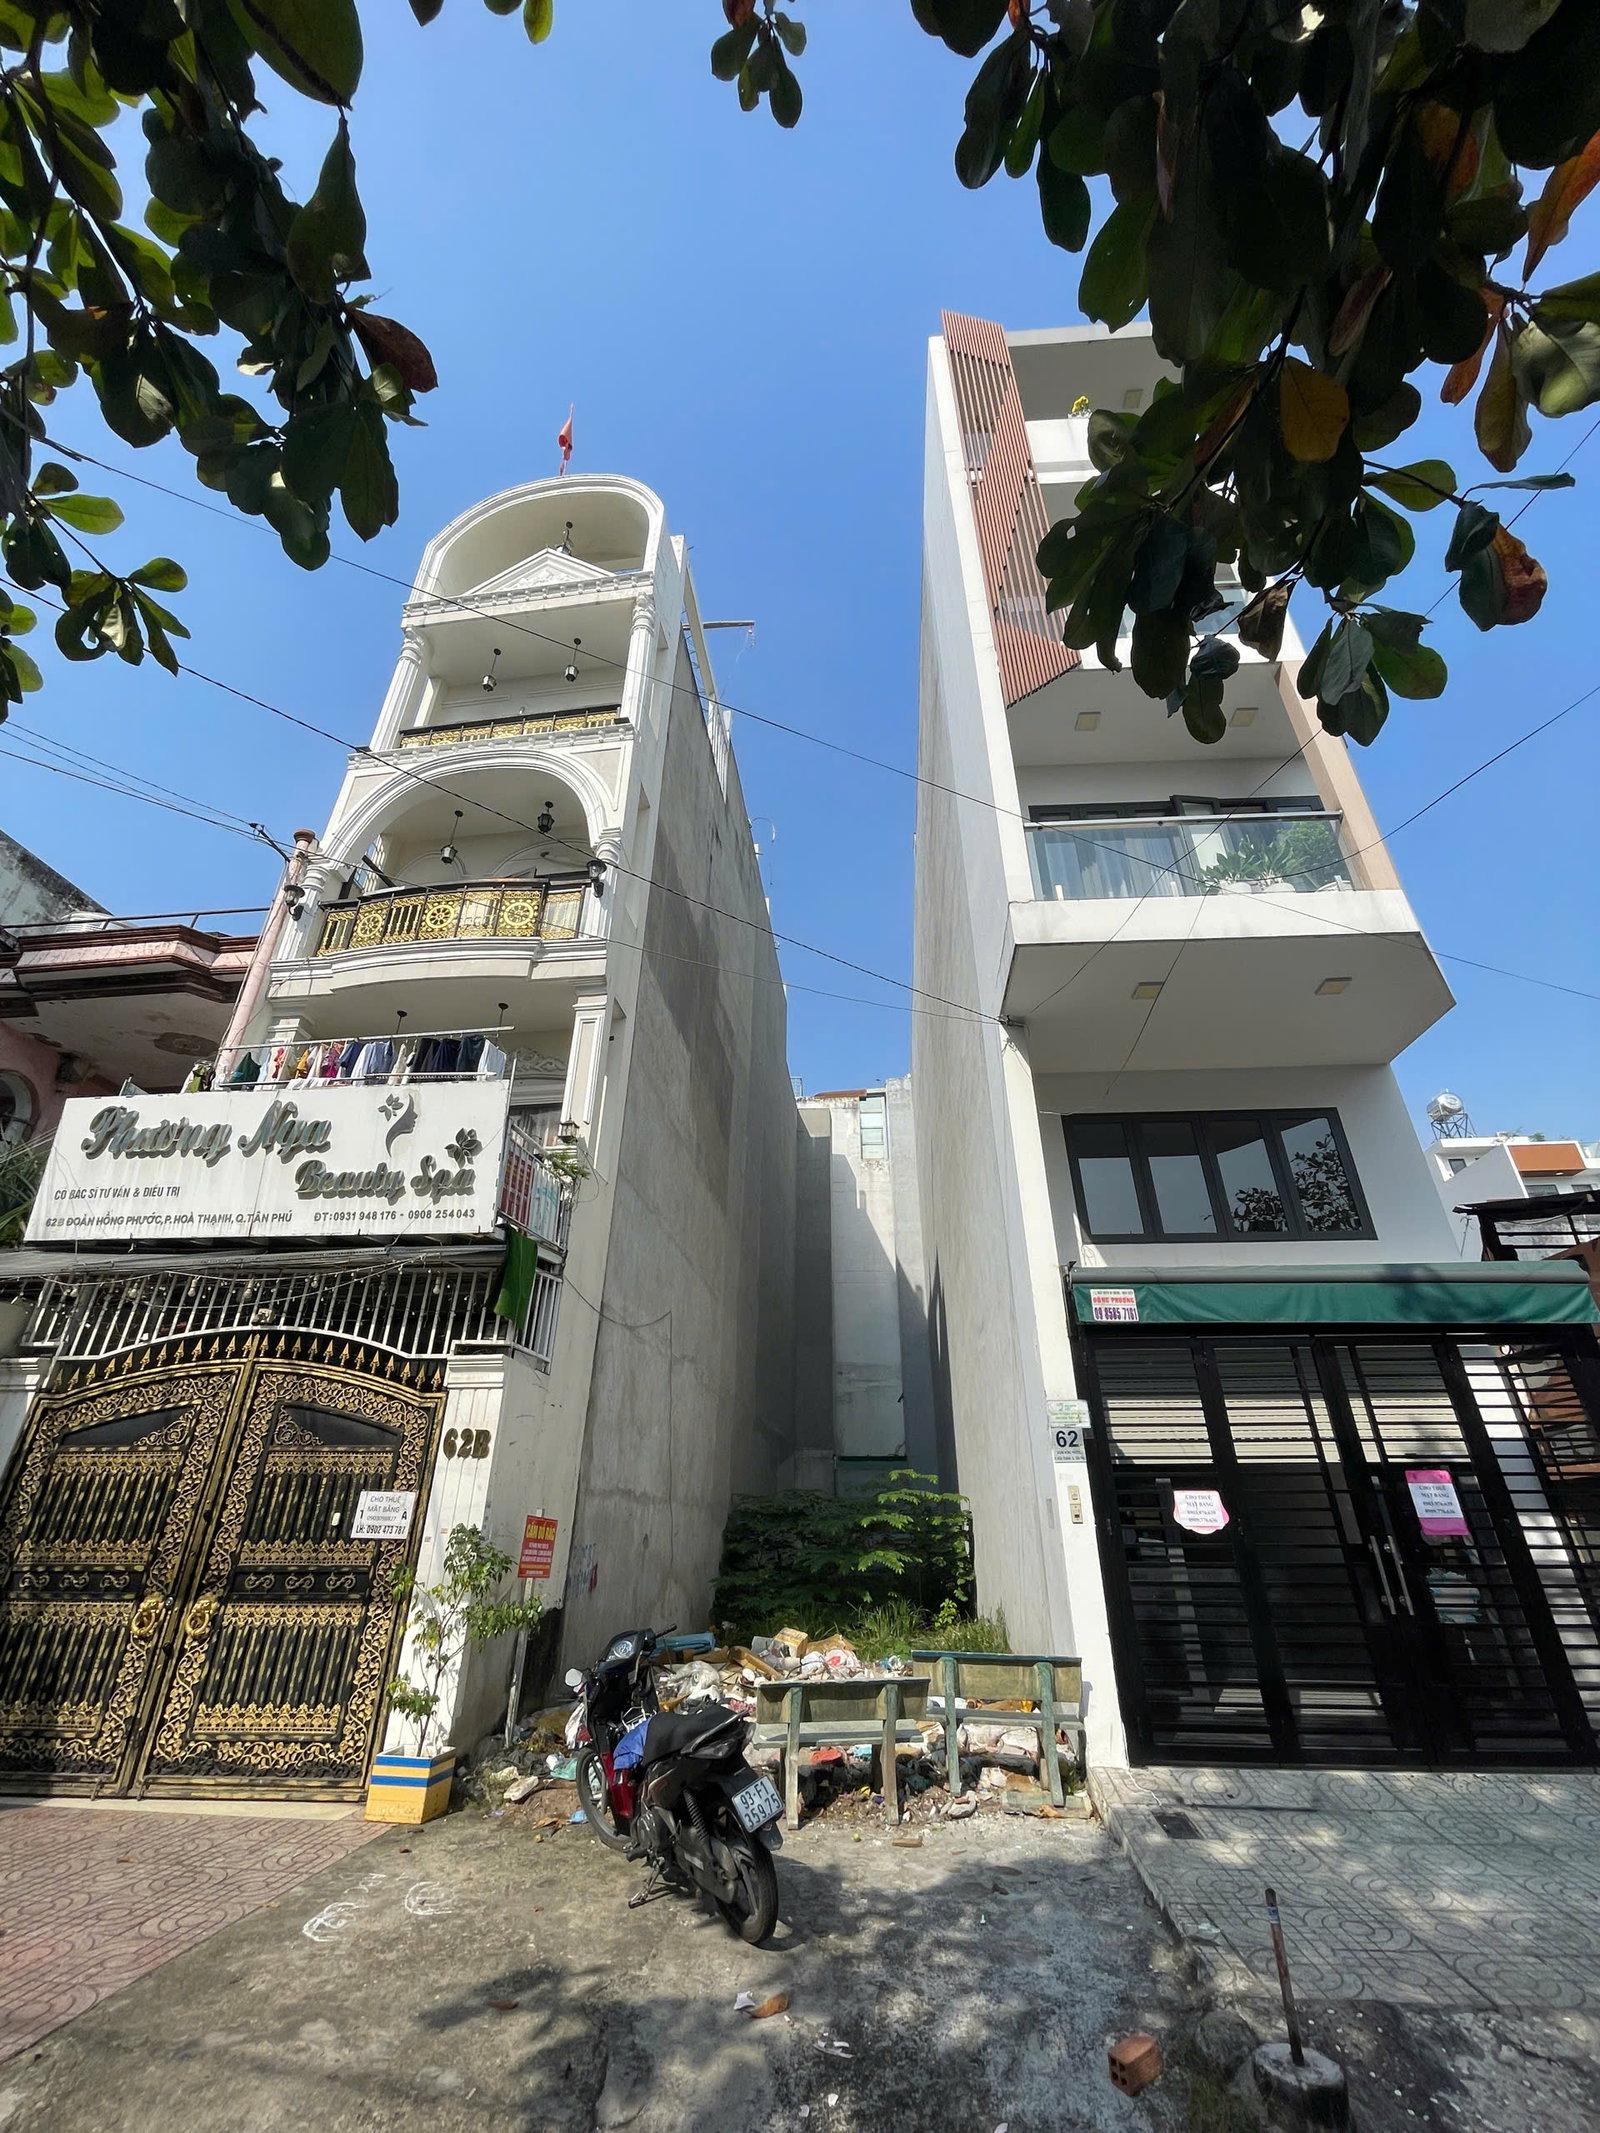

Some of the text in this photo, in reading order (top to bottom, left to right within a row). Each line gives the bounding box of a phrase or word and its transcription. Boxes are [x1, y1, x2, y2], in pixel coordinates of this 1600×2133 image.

[81, 1100, 331, 1167] Phương Nga
[295, 1160, 406, 1206] Beauty
[410, 1155, 476, 1205] Spa
[69, 1186, 87, 1199] BÁC
[99, 1186, 112, 1198] TƯ
[133, 1187, 140, 1197] &
[166, 1186, 180, 1198] TRỊ
[46, 1217, 65, 1227] 62B
[66, 1213, 96, 1226] ĐOÀN
[271, 1210, 293, 1223] PHÚ
[359, 1210, 377, 1220] 948
[380, 1210, 397, 1220] 176
[408, 1209, 432, 1220] 0908
[435, 1209, 454, 1219] 254
[456, 1208, 475, 1218] 043
[443, 1428, 491, 1460] 62B
[1056, 1430, 1079, 1448] 62
[356, 1525, 406, 1535] LH: 0902 473 787
[744, 1793, 781, 1828] 359.75
